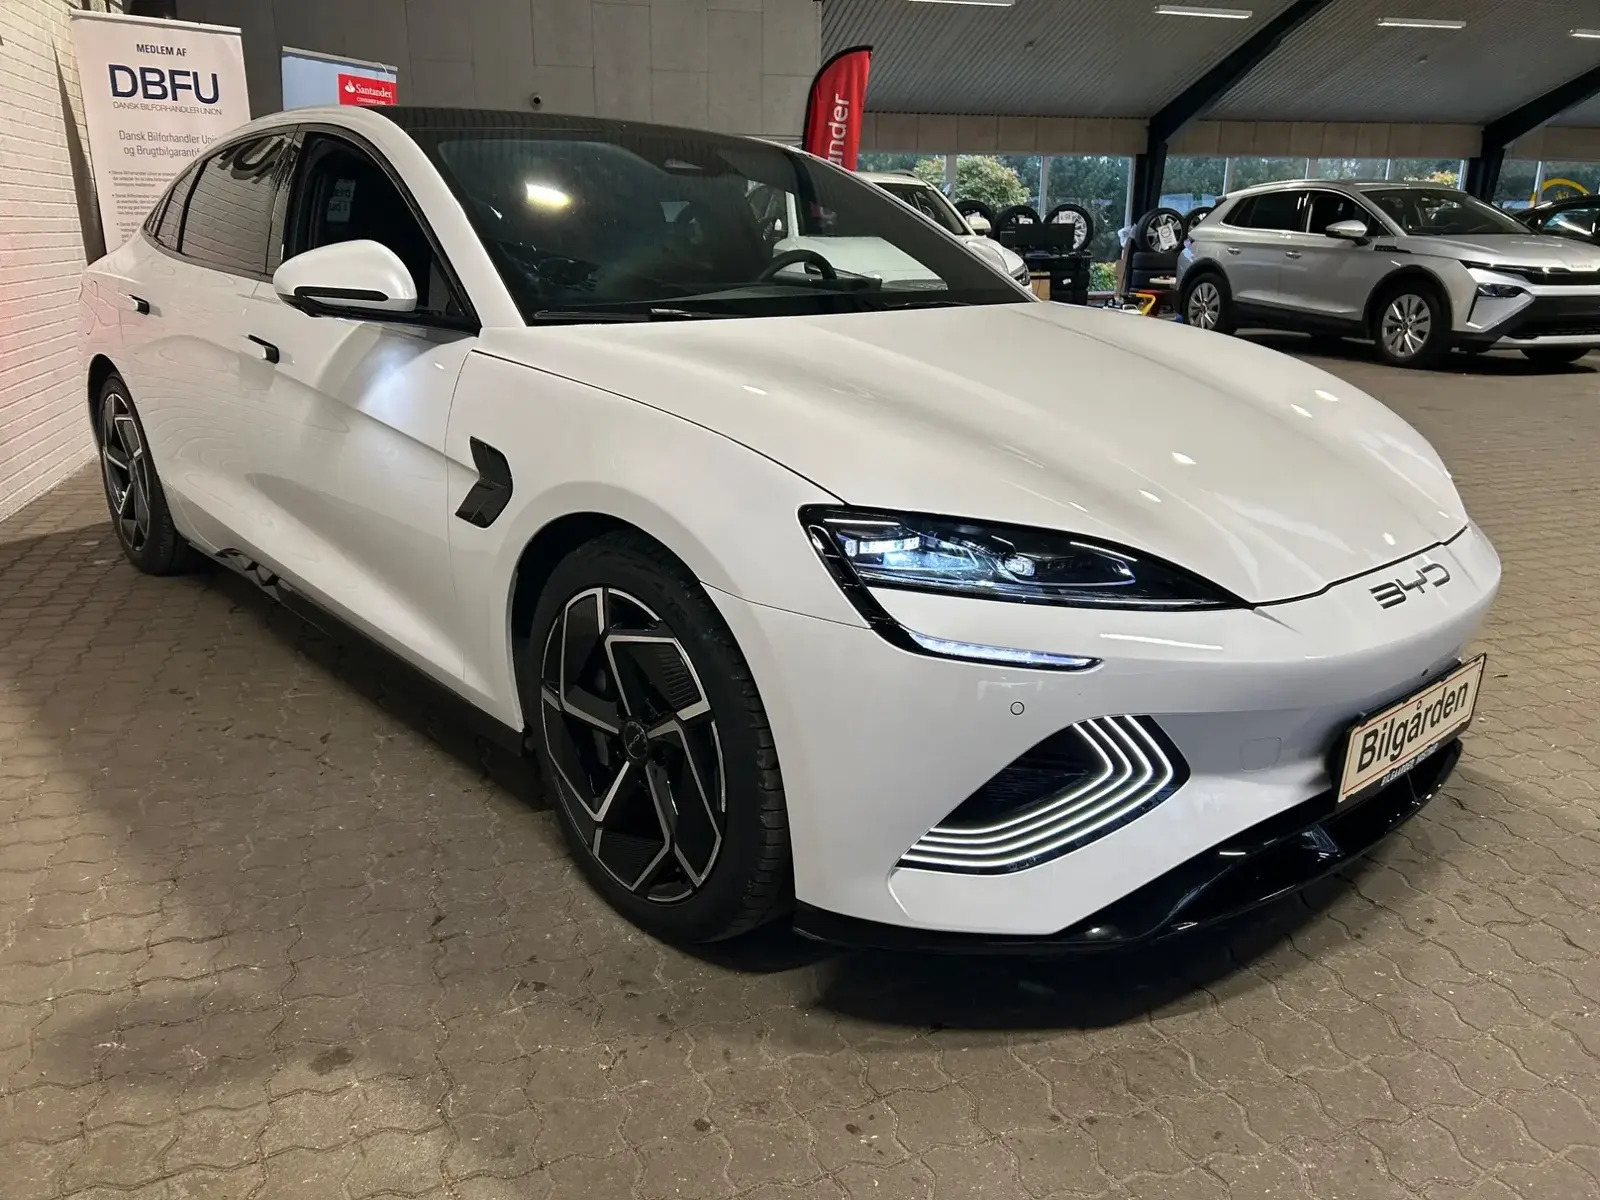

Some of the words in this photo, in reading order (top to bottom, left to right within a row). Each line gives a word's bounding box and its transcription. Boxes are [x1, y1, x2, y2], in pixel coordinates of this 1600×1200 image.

[136, 43, 174, 55] MEDLEM
[176, 48, 187, 57] AF
[108, 64, 220, 105] DBFU
[355, 83, 392, 98] Santander
[113, 101, 140, 110] DANSK
[140, 103, 200, 113] BILFORHANDLER
[200, 107, 222, 115] UNION
[119, 130, 146, 140] Dansk
[147, 131, 200, 143] Bilforhandler
[124, 146, 134, 157] og
[1368, 562, 1451, 610] BYD
[1356, 682, 1469, 774] Bilgården
